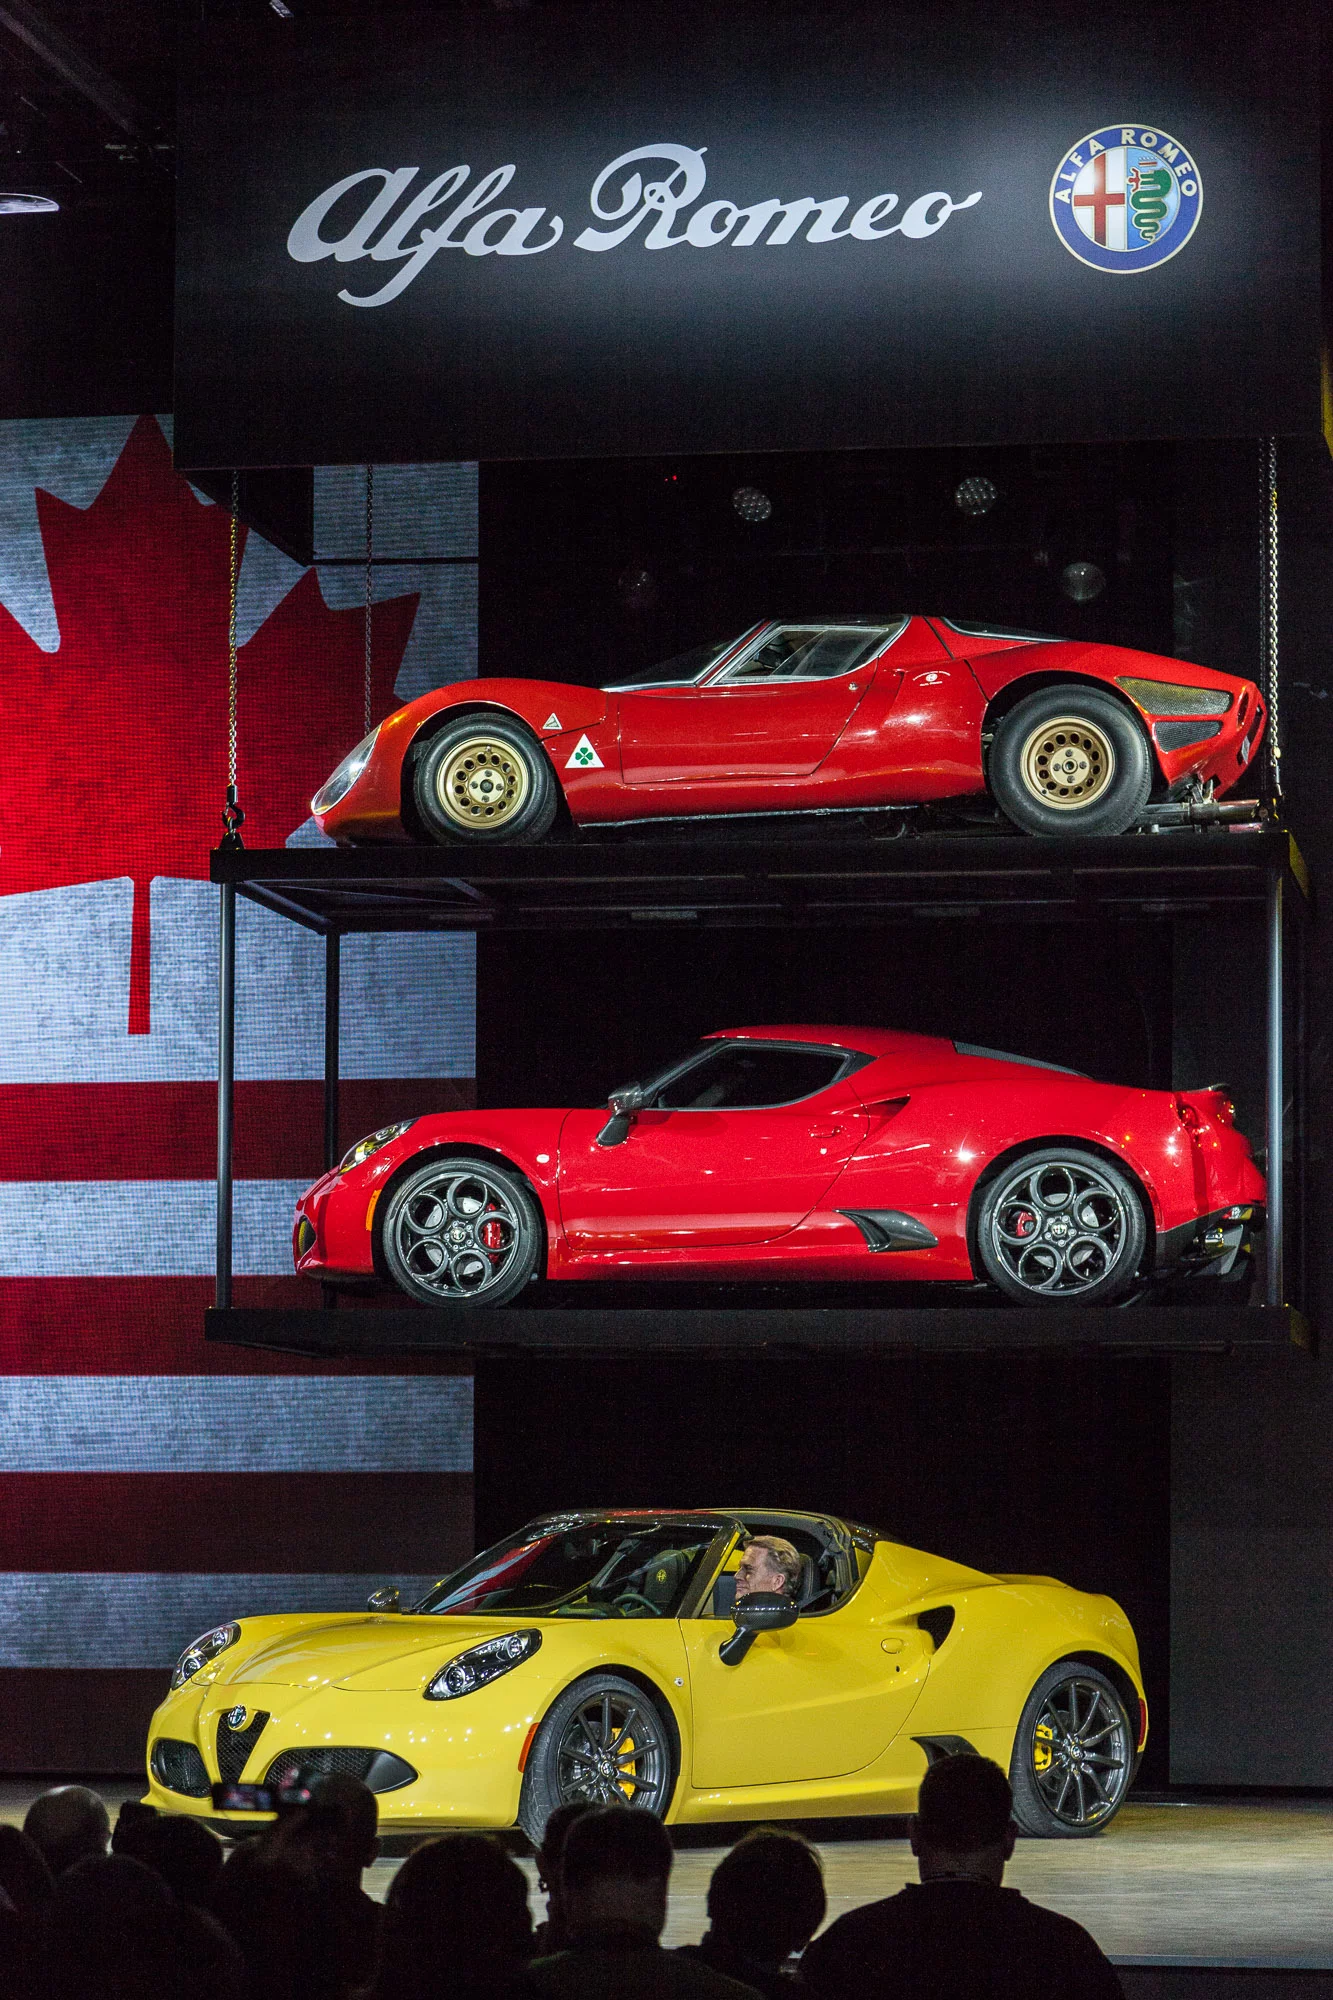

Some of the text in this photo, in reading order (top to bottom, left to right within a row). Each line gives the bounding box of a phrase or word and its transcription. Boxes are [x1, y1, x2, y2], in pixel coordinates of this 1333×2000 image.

[287, 143, 983, 308] Alfa Romeo
[1054, 128, 1198, 205] ALFA ROMEO
